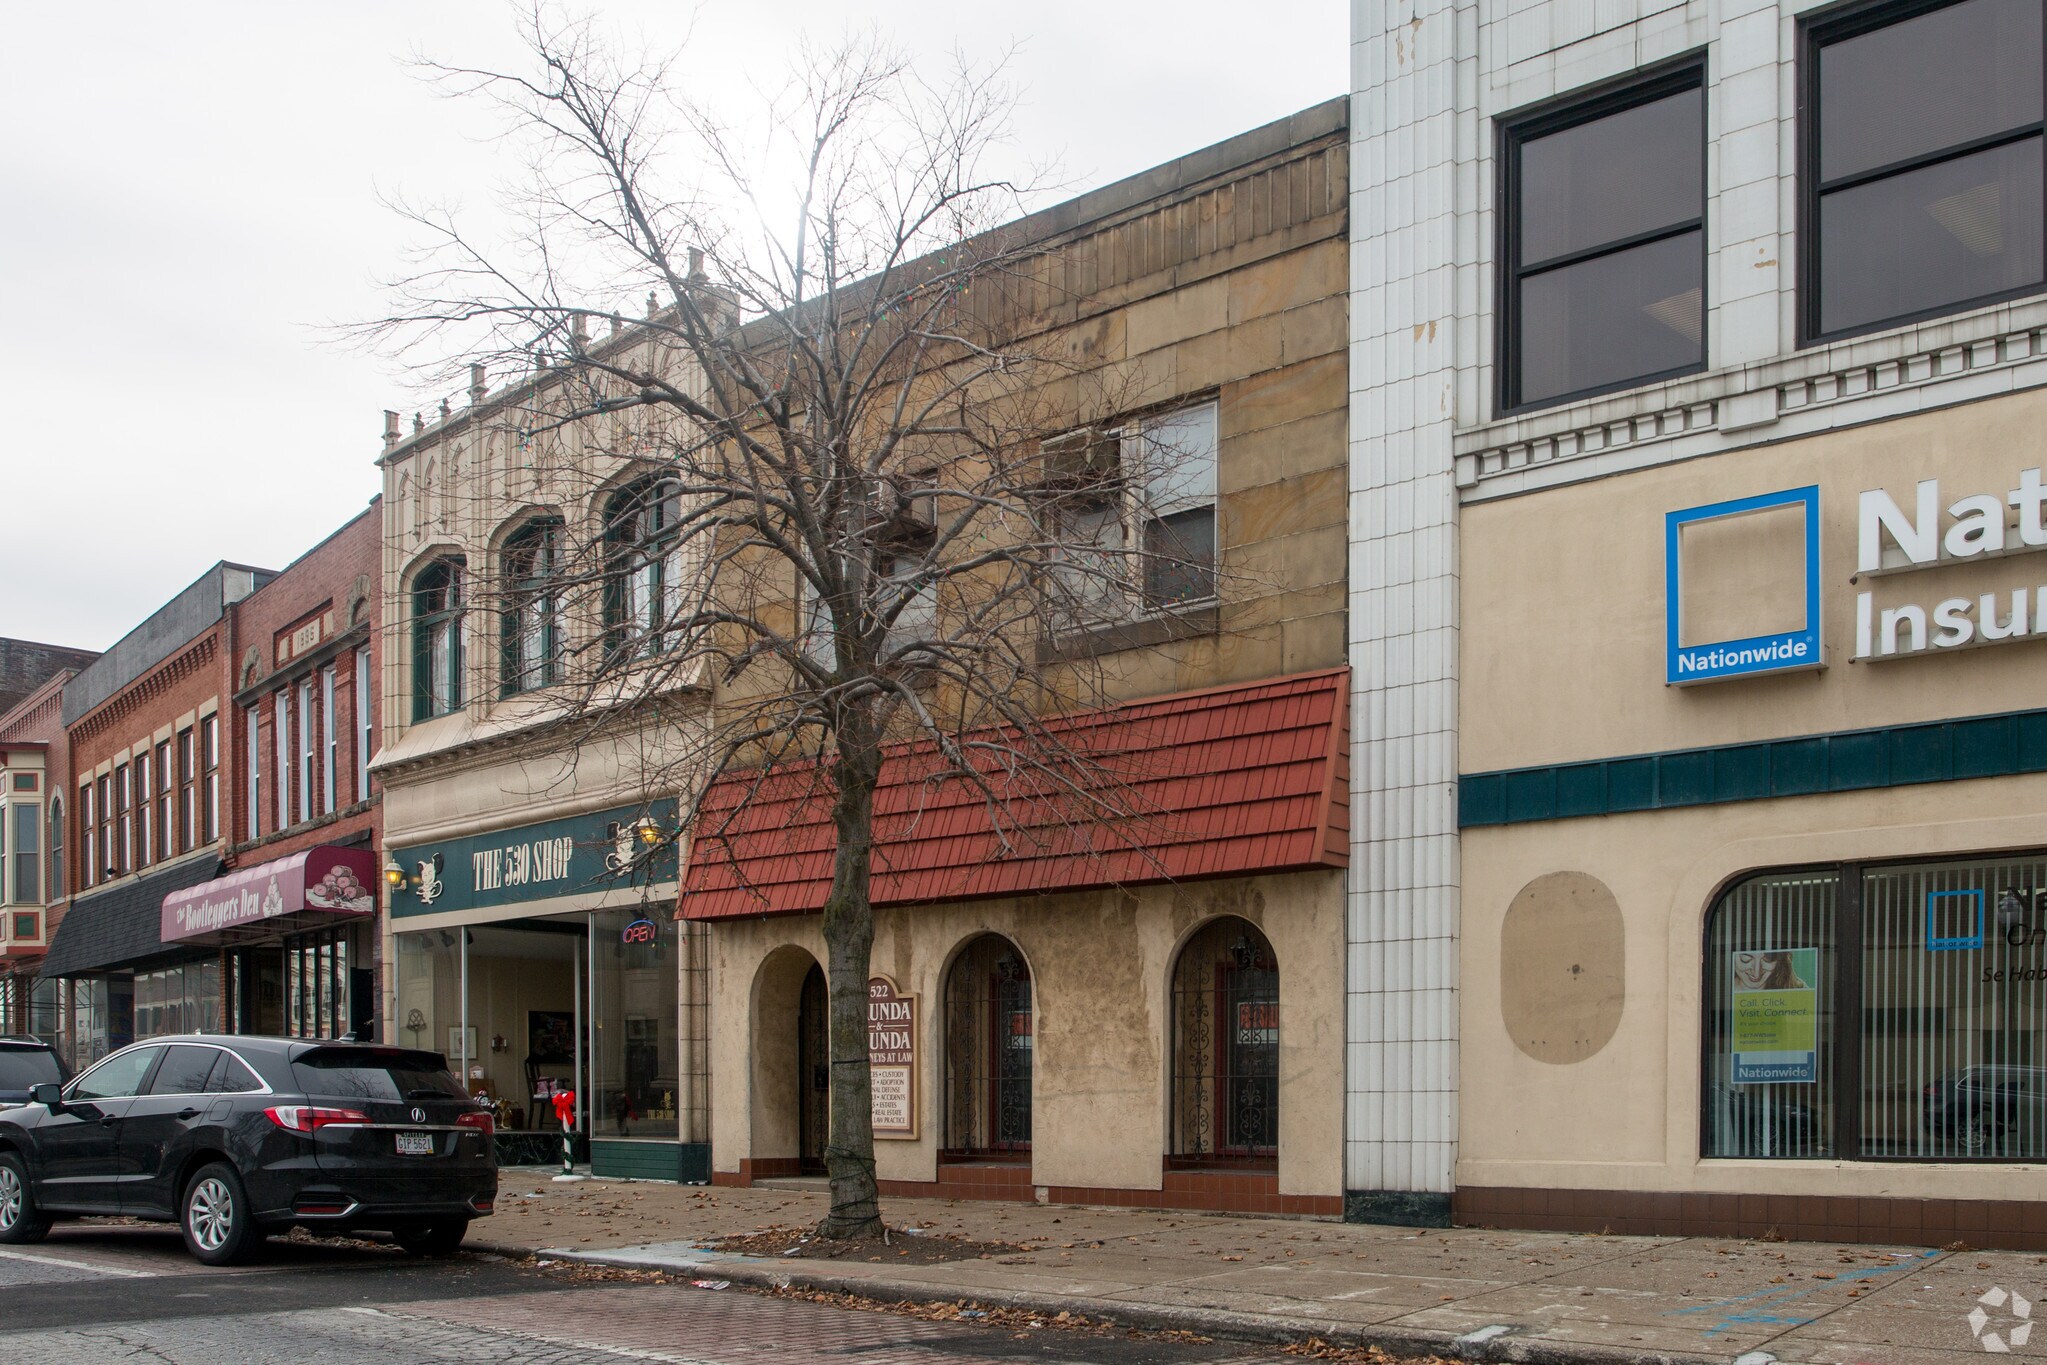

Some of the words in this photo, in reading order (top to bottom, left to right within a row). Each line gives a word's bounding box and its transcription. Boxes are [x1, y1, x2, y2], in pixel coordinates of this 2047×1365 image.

[472, 847, 502, 892] THE
[504, 844, 530, 887] 530
[532, 836, 574, 883] SHOP
[185, 896, 239, 931] Bootleggers
[240, 888, 260, 918] Den
[625, 924, 656, 944] OPEN
[1982, 966, 2004, 983] Se
[869, 984, 889, 998] 522
[868, 1001, 912, 1021] UNDA
[876, 1021, 884, 1031] &
[868, 1031, 912, 1050] UNDA
[887, 1052, 897, 1063] AT
[897, 1052, 913, 1063] LAW
[879, 1101, 897, 1109] ESTATES
[883, 1116, 906, 1124] PRACTICE
[397, 1138, 412, 1150] GIP
[413, 1138, 431, 1150] 5621
